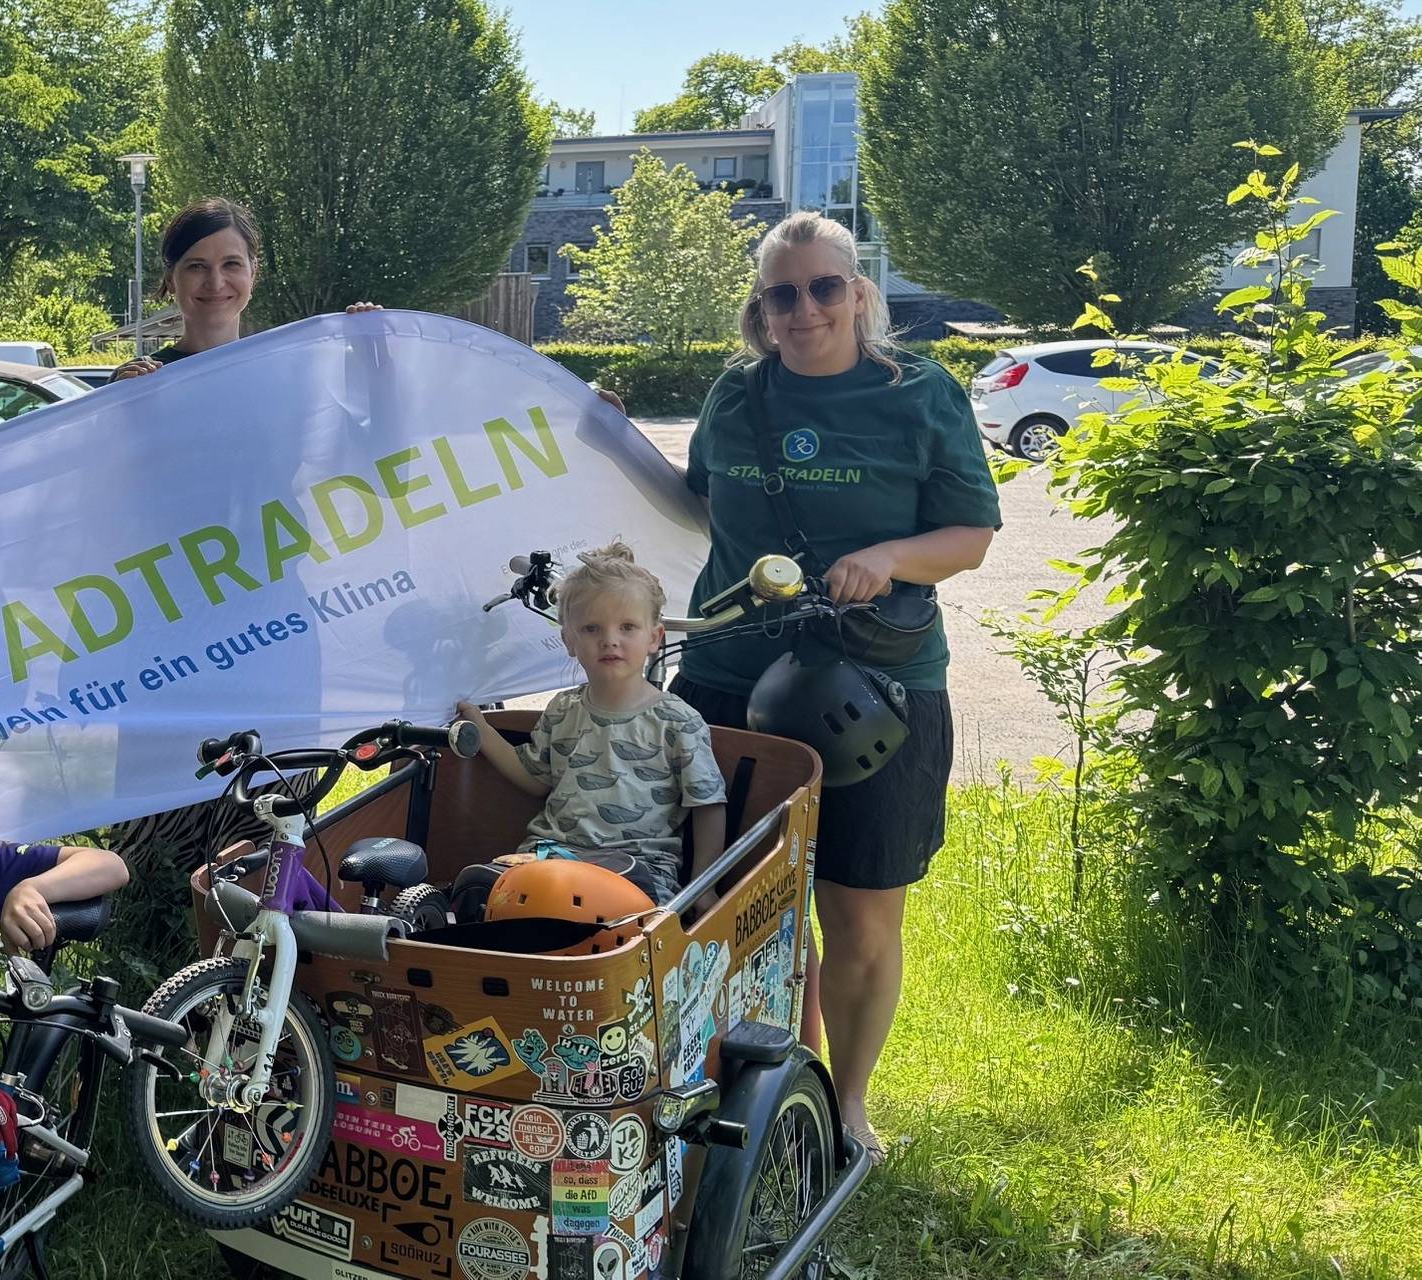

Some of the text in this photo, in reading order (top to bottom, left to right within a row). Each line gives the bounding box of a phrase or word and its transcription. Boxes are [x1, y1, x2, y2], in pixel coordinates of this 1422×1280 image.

[727, 465, 861, 483] STATRADELN
[69, 678, 129, 716] für
[139, 651, 199, 691] ein
[205, 609, 309, 672] gutes
[308, 565, 415, 625] Klima
[263, 847, 283, 898] woom
[735, 885, 777, 948] BABBOE
[531, 977, 605, 993] WELCOME
[559, 995, 578, 1008] TO
[543, 1007, 594, 1021] WATER
[601, 1053, 629, 1067] zero
[572, 1073, 618, 1093] ALEN
[622, 1077, 644, 1094] RUZ
[465, 1103, 511, 1125] FCK
[523, 1113, 542, 1123] kein
[446, 1099, 456, 1157] INDEPENDENT
[464, 1120, 511, 1142] NZS
[518, 1122, 553, 1134] mensch
[522, 1133, 533, 1142] ist
[529, 1144, 548, 1154] egal
[471, 1150, 542, 1174] REFUGEES
[318, 1140, 453, 1211] ABBOE
[563, 1175, 599, 1185] so, dass
[471, 1186, 542, 1210] WELCOME
[565, 1189, 598, 1200] die AfD
[572, 1205, 592, 1213] was
[483, 1221, 500, 1230] WITH
[501, 1225, 518, 1242] STYLE
[563, 1217, 600, 1230] dagegen
[290, 1220, 347, 1246] DURABLE GOODS
[461, 1243, 527, 1264] FOURASSES
